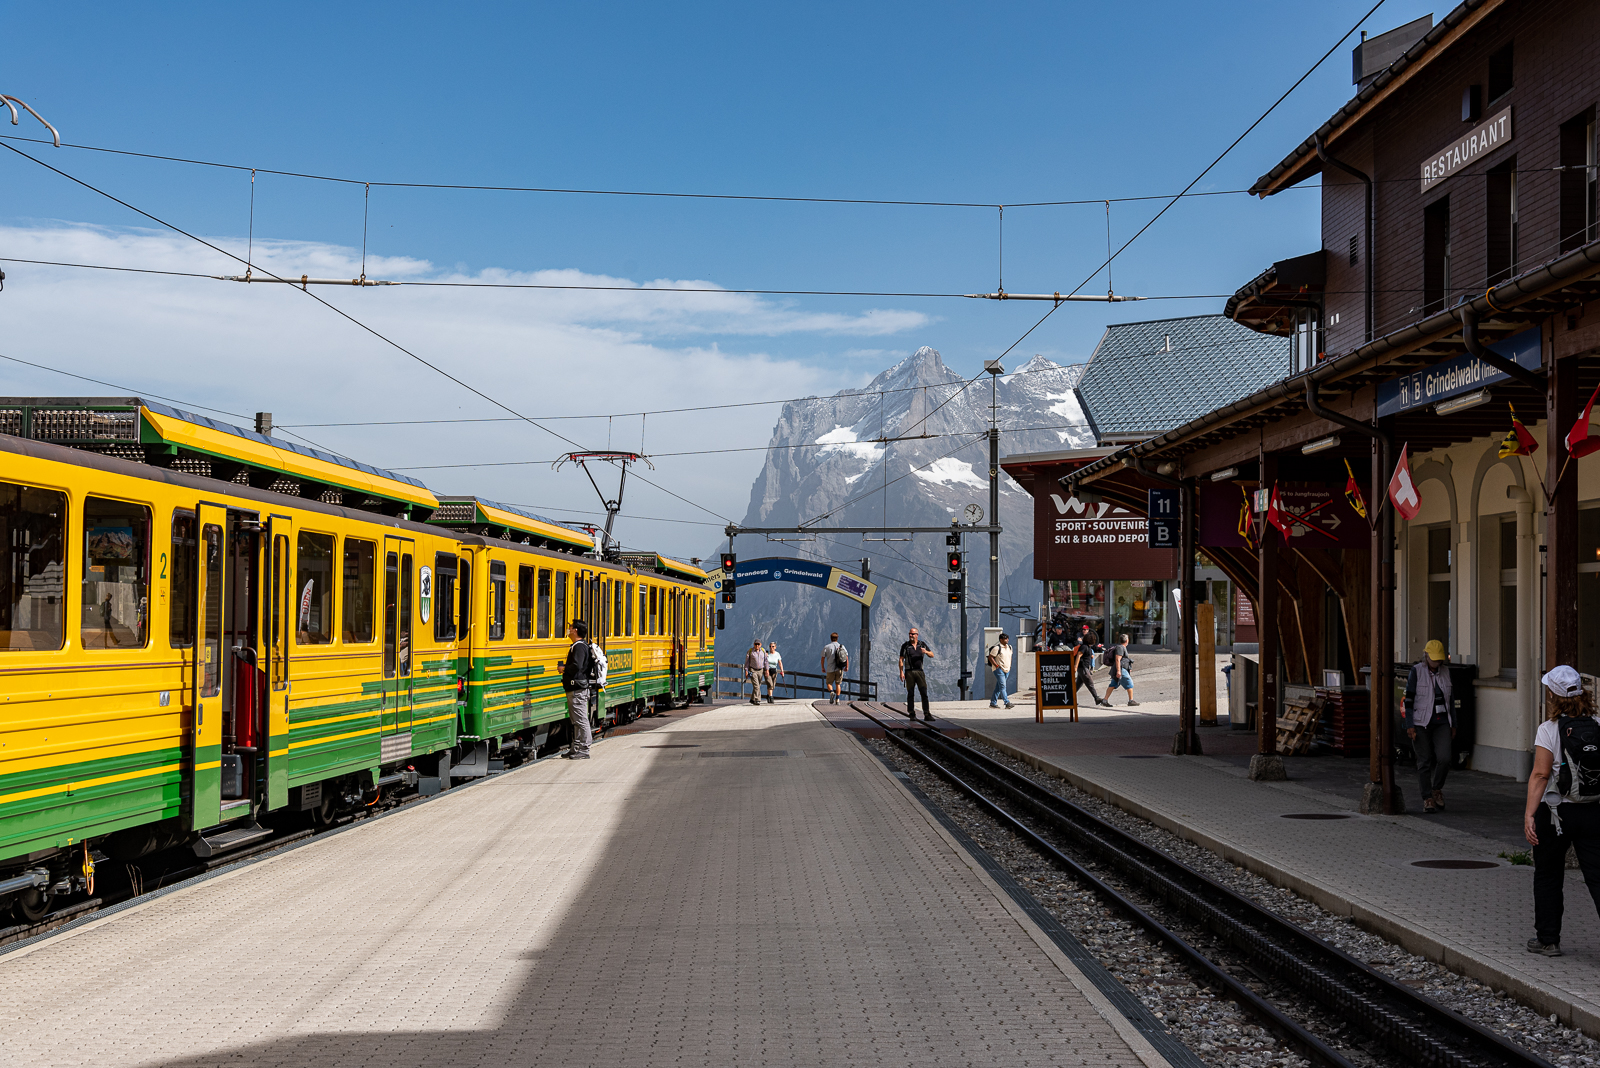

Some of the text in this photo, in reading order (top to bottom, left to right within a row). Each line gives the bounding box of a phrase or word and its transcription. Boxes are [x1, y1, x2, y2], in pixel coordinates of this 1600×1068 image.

[1424, 115, 1507, 185] RESTAURANT
[1401, 385, 1408, 404] 11
[1414, 381, 1421, 401] B
[1425, 358, 1480, 397] Grindelwald
[1157, 498, 1171, 513] 11
[1055, 522, 1087, 531] SPORT
[1157, 526, 1170, 541] B
[1054, 535, 1070, 544] SKI
[1072, 535, 1080, 544] &
[1082, 534, 1116, 543] BOARD
[160, 552, 167, 579] 2
[736, 569, 769, 578] Brandegg
[783, 568, 824, 578] Grindelwald
